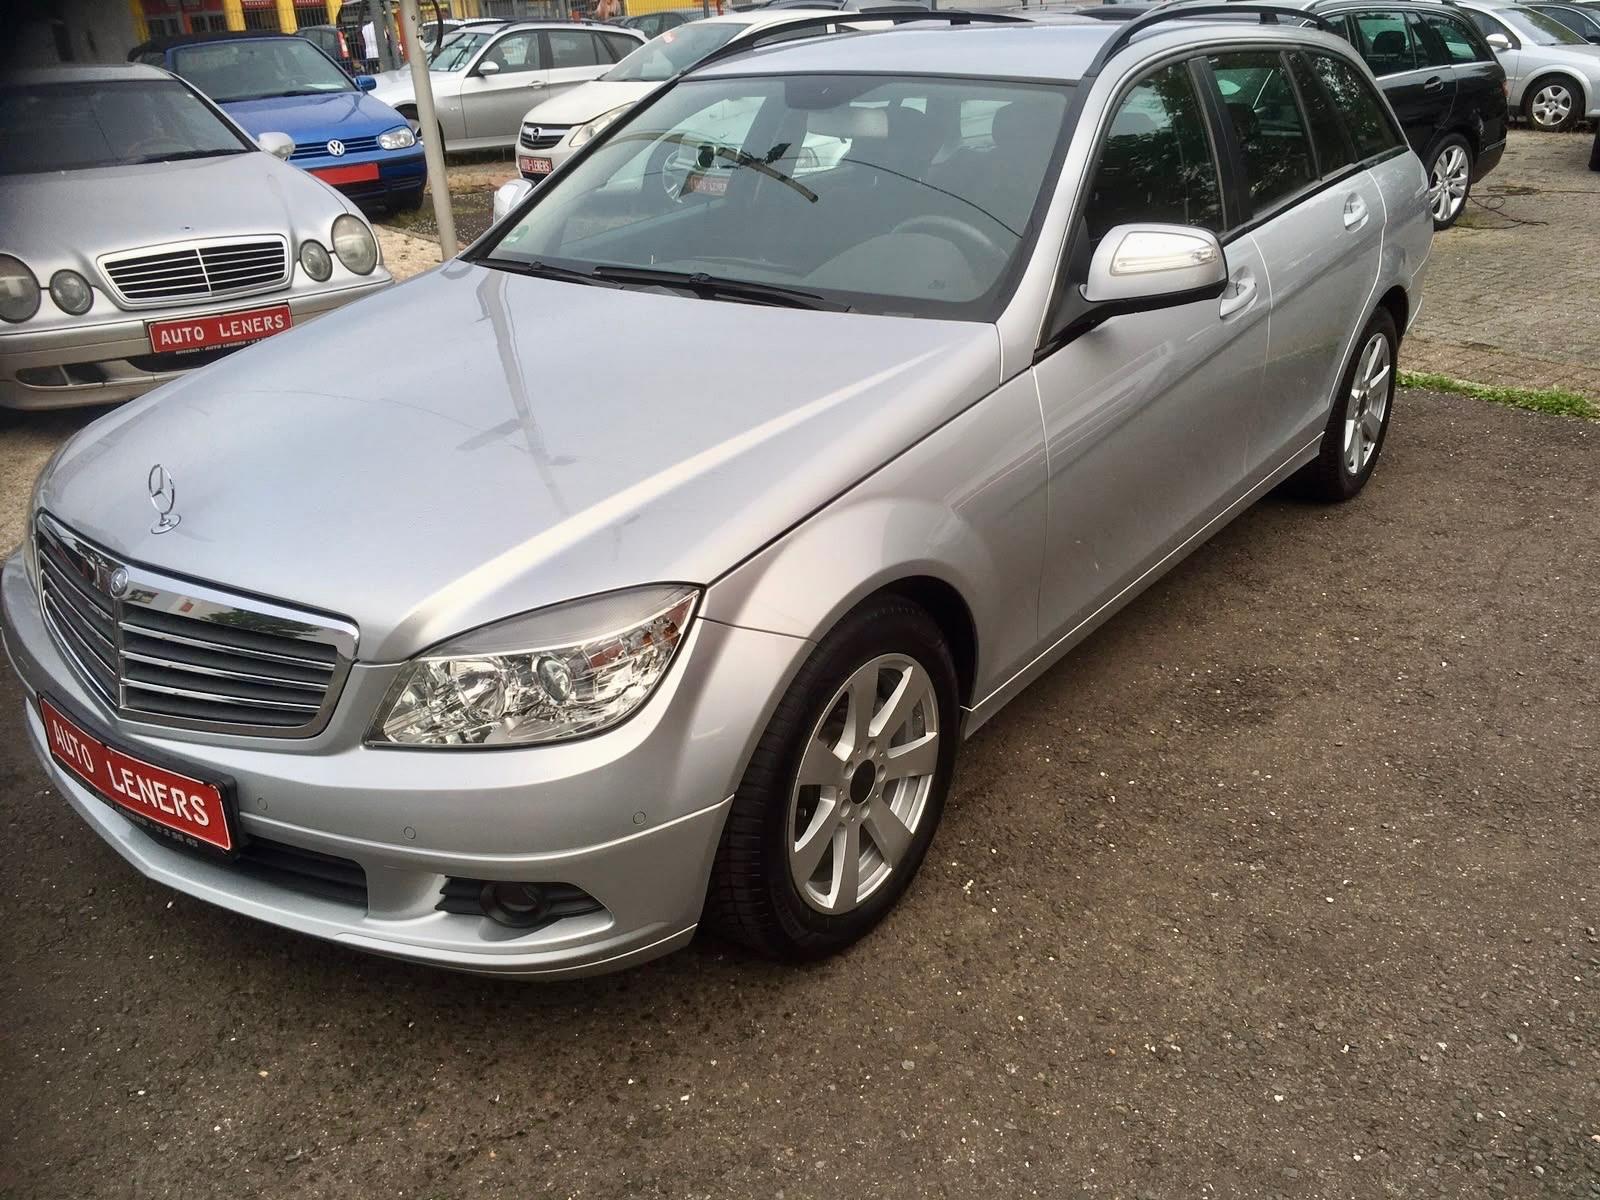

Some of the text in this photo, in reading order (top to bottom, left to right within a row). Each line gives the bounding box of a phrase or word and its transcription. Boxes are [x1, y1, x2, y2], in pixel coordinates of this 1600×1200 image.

[161, 315, 284, 345] AUTO LENERS
[53, 720, 209, 826] AUTO LENERS
